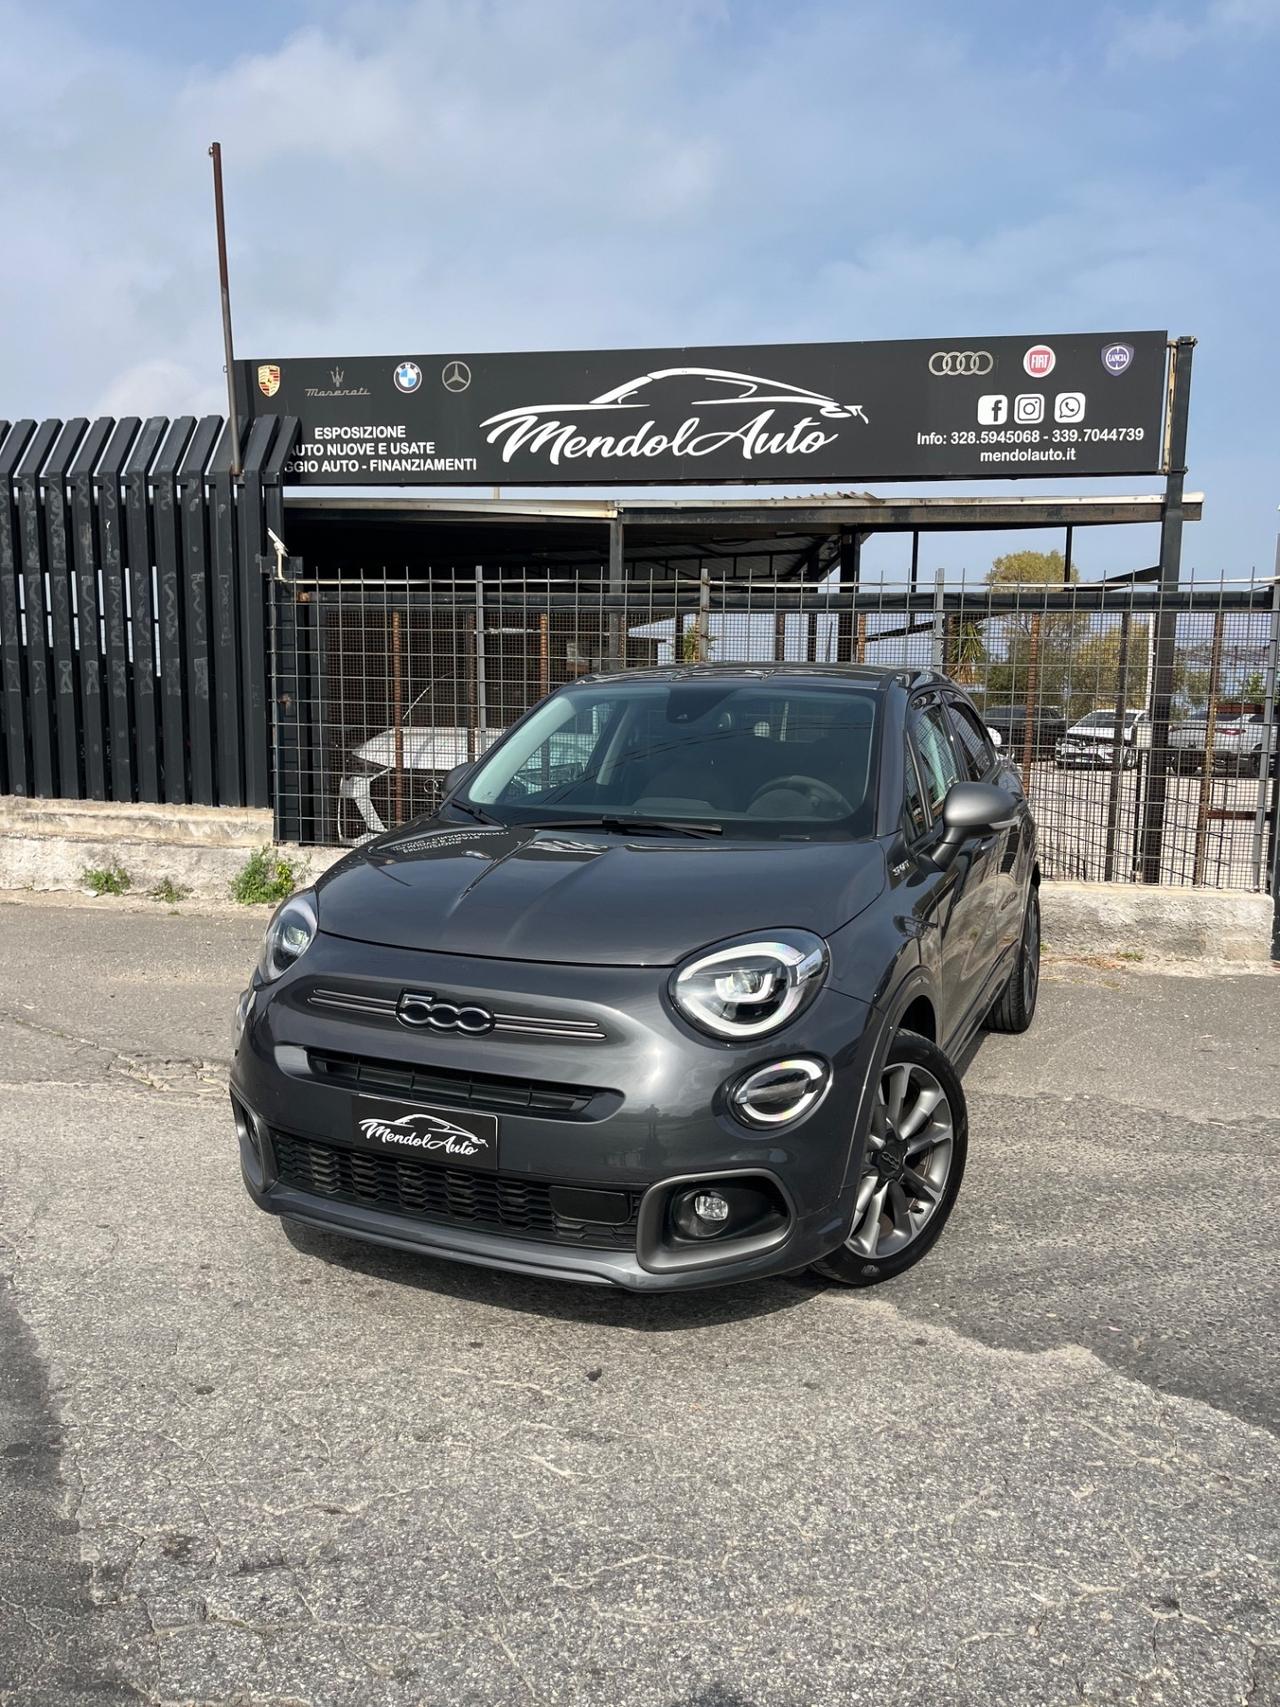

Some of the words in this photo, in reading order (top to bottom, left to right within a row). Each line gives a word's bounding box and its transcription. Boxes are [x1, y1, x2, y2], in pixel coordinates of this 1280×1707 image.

[1031, 354, 1050, 369] FIAT
[304, 387, 371, 397] Maserati
[314, 425, 407, 440] ESPOSIZIONE
[486, 409, 839, 466] MendolAuto
[916, 432, 947, 445] Info:
[950, 430, 1040, 445] 328.5945068
[1051, 428, 1145, 443] 339.7044739
[327, 442, 375, 456] NUOVE
[378, 442, 387, 455] E
[390, 441, 436, 455] USATE
[980, 447, 1077, 462] mendolauto.it
[321, 459, 359, 473] AUTO
[369, 458, 477, 472] FINANZIAMENTI
[399, 993, 491, 1032] 500
[361, 1122, 479, 1156] MendolAuto
